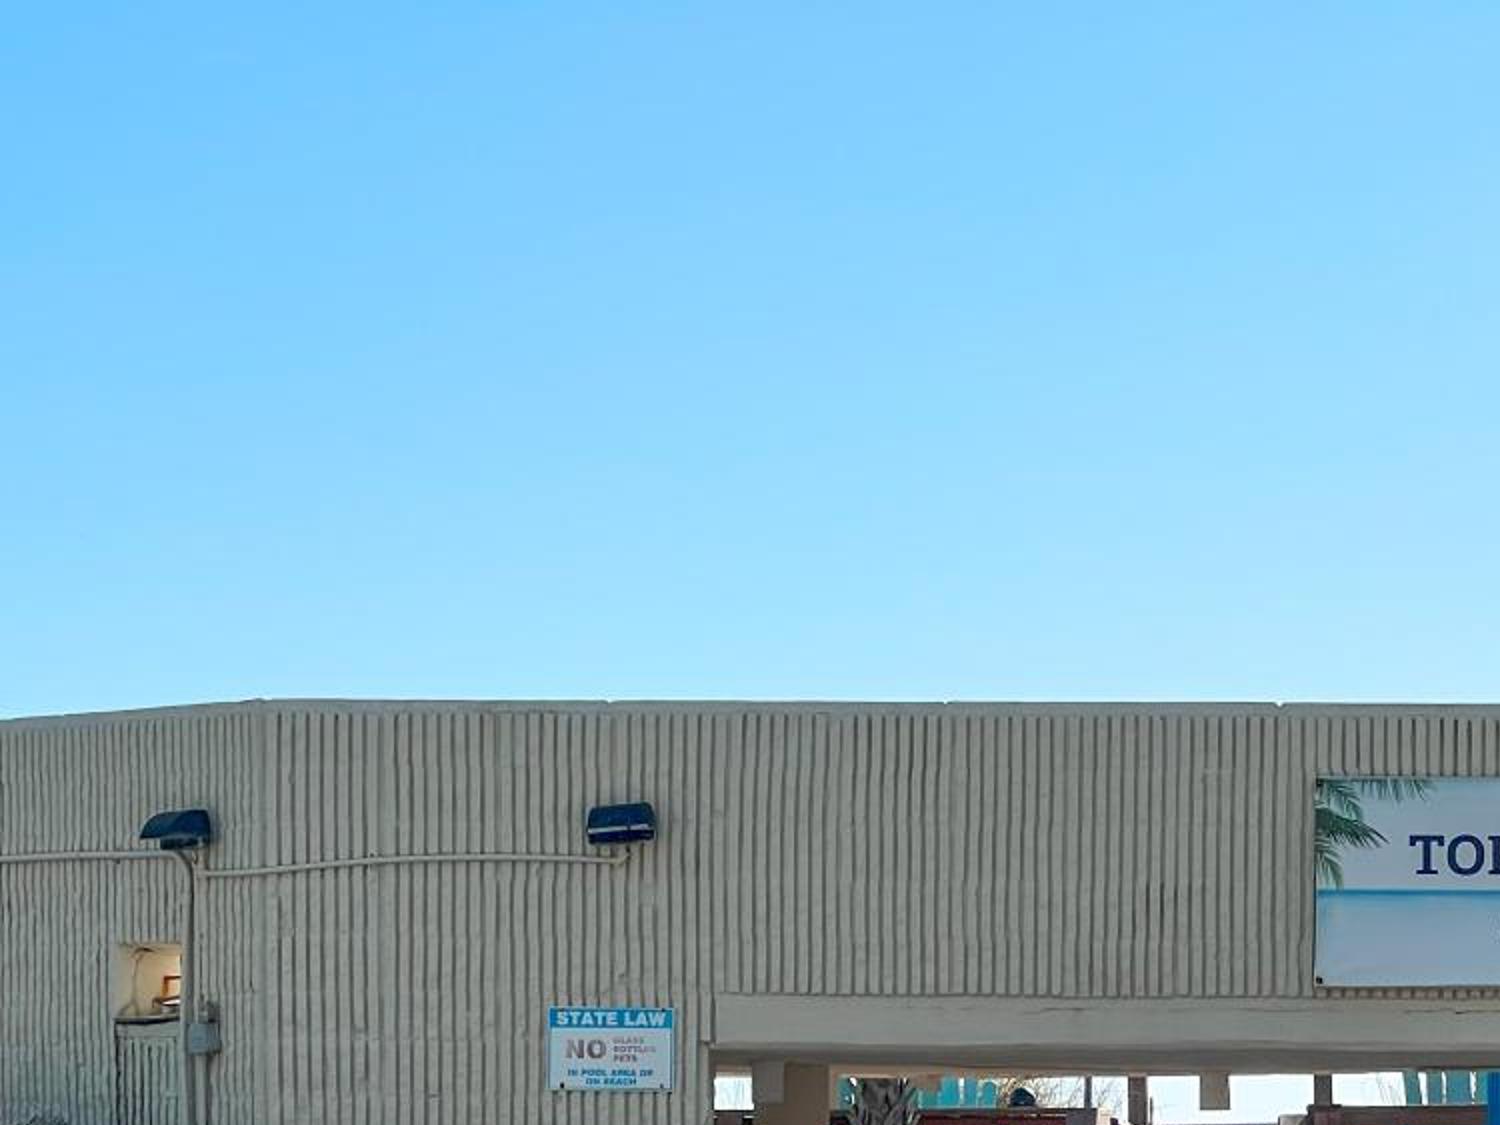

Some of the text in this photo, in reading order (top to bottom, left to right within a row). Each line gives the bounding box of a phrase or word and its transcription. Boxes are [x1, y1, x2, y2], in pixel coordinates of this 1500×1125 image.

[556, 1011, 667, 1027] STATE LAW
[565, 1039, 607, 1059] NO
[613, 1054, 638, 1063] PETS
[567, 1069, 579, 1077] IN
[581, 1069, 608, 1077] POOL
[611, 1069, 637, 1077] AREA
[603, 1077, 638, 1085] BEACH
